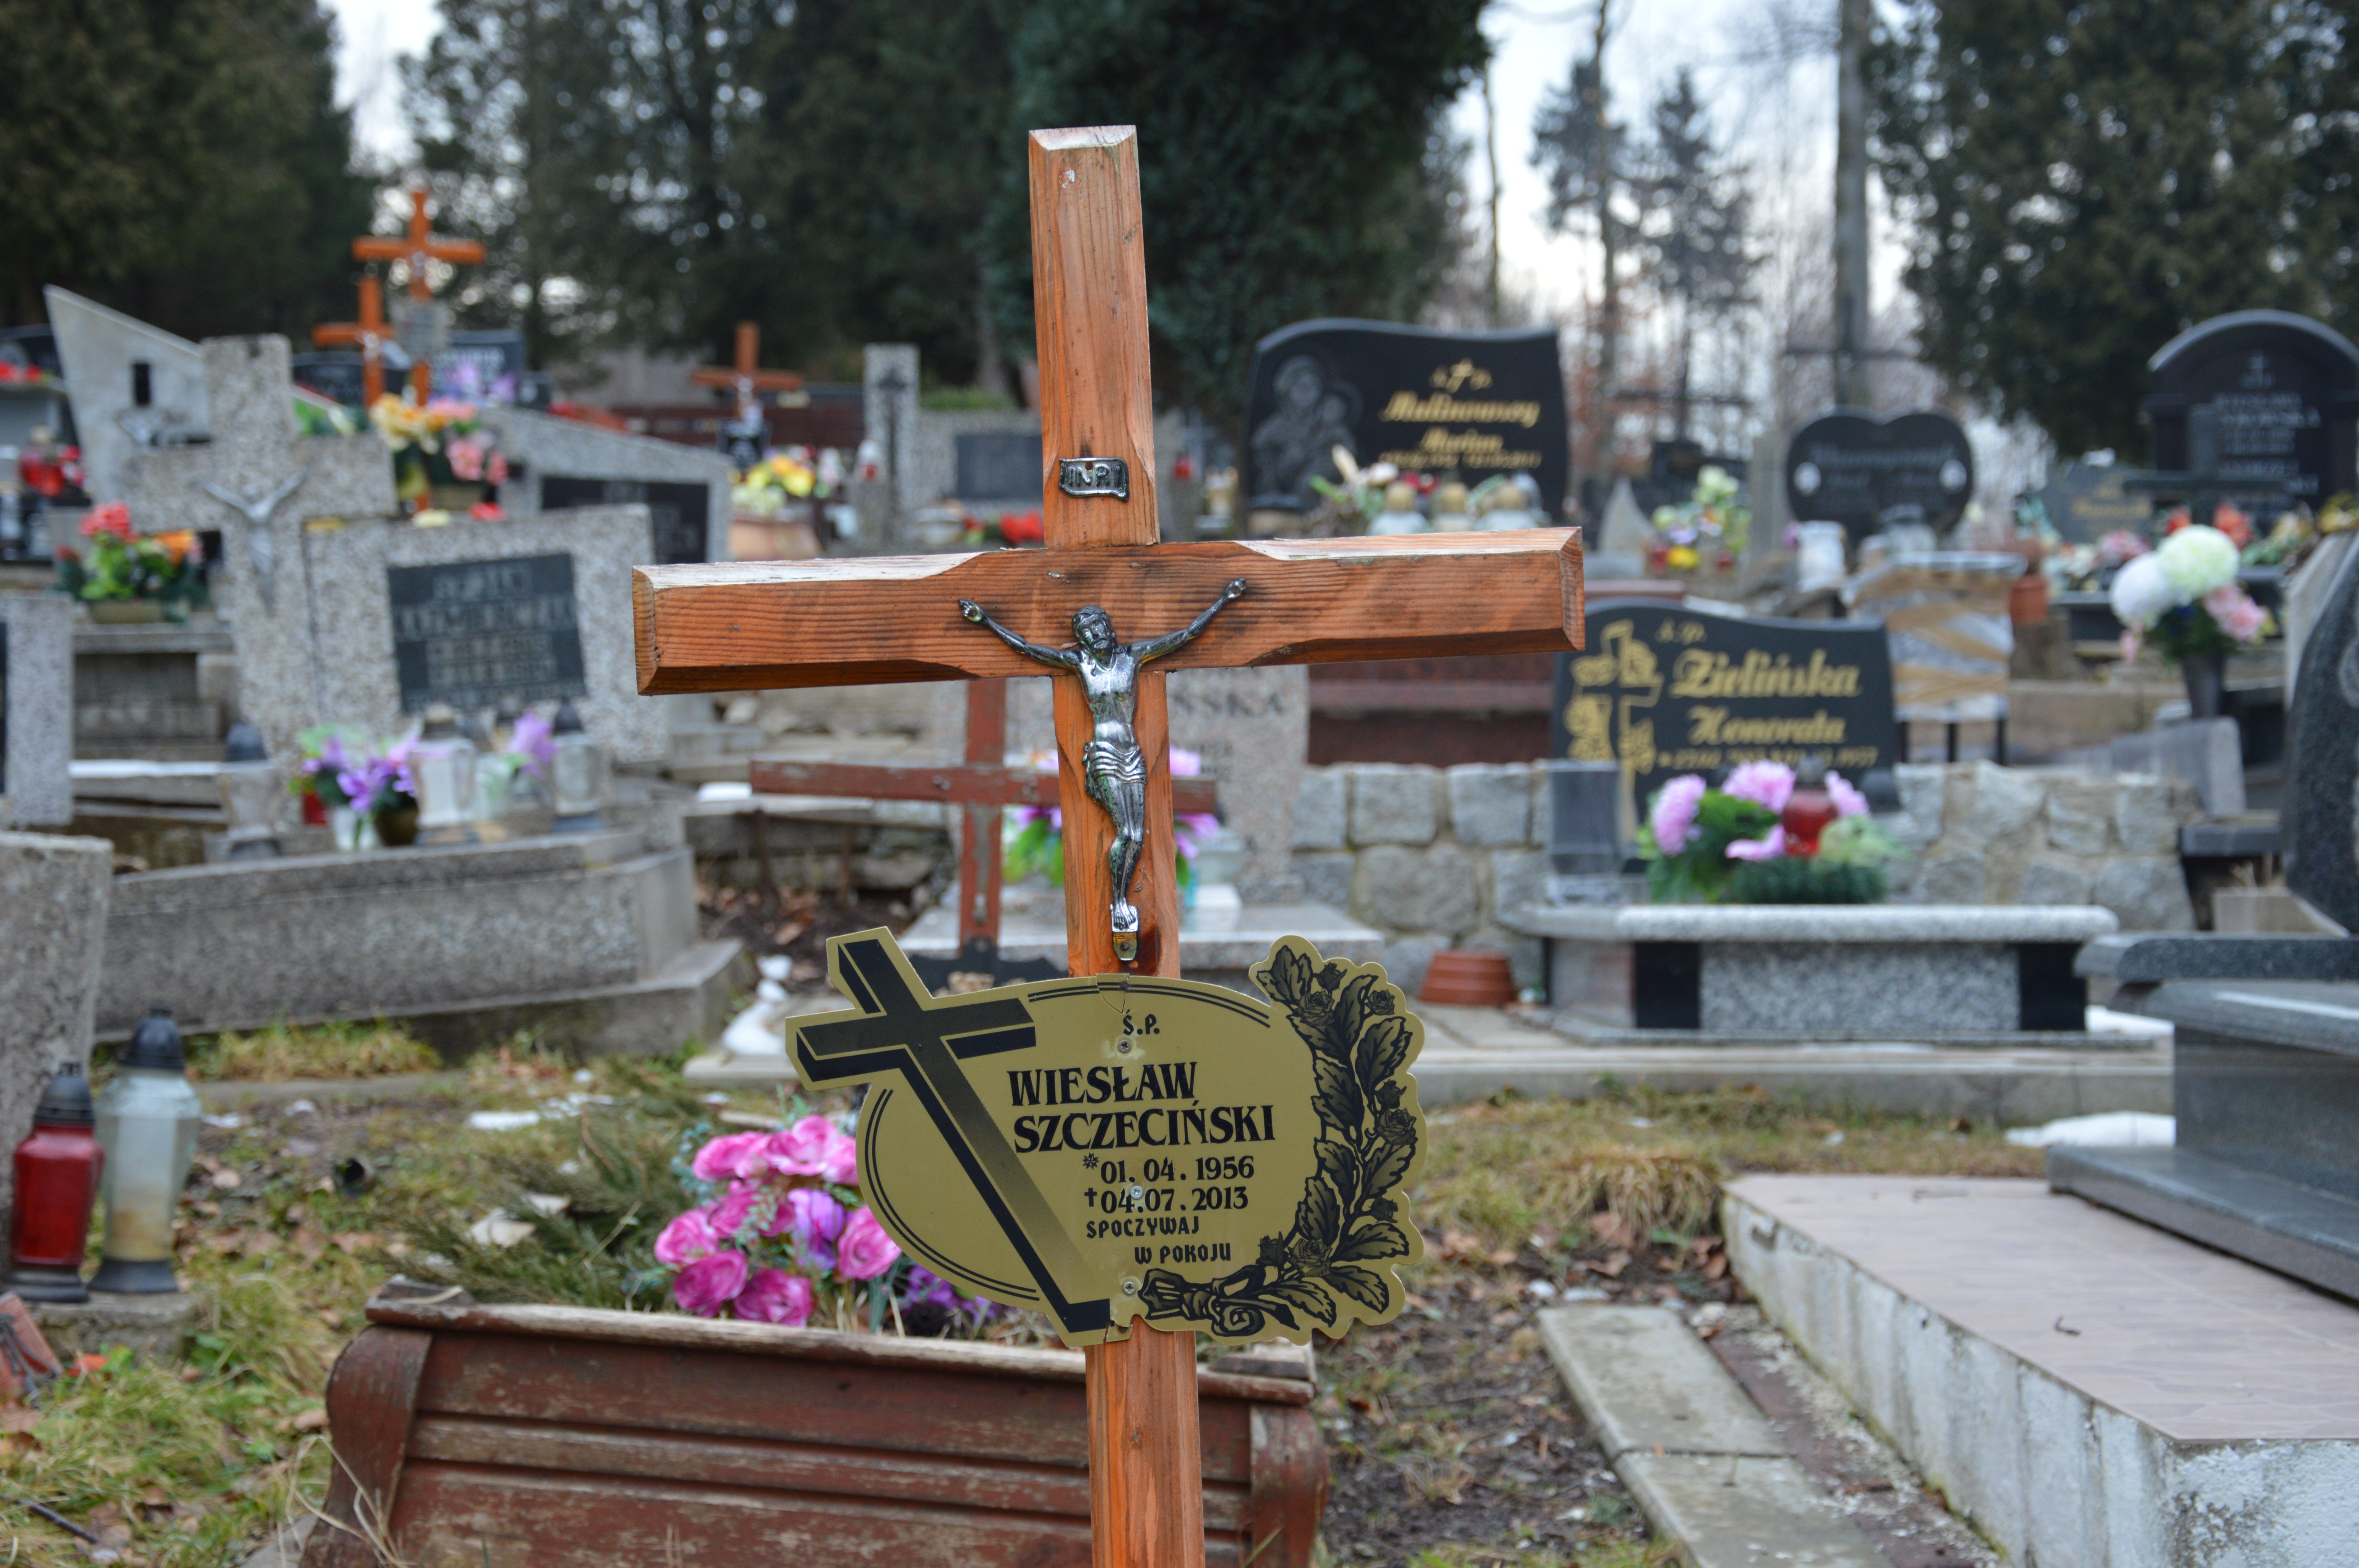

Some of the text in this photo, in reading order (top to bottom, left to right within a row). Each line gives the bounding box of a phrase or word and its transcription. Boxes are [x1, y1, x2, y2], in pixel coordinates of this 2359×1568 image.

[1067, 463, 1121, 487] INRI
[1007, 1061, 1198, 1106] WIESŁAW
[1014, 1099, 1276, 1154] SZCZECIŃSKI
[1086, 1216, 1200, 1239] SPOCZYWAJ
[1134, 1243, 1231, 1264] W POKOJU
